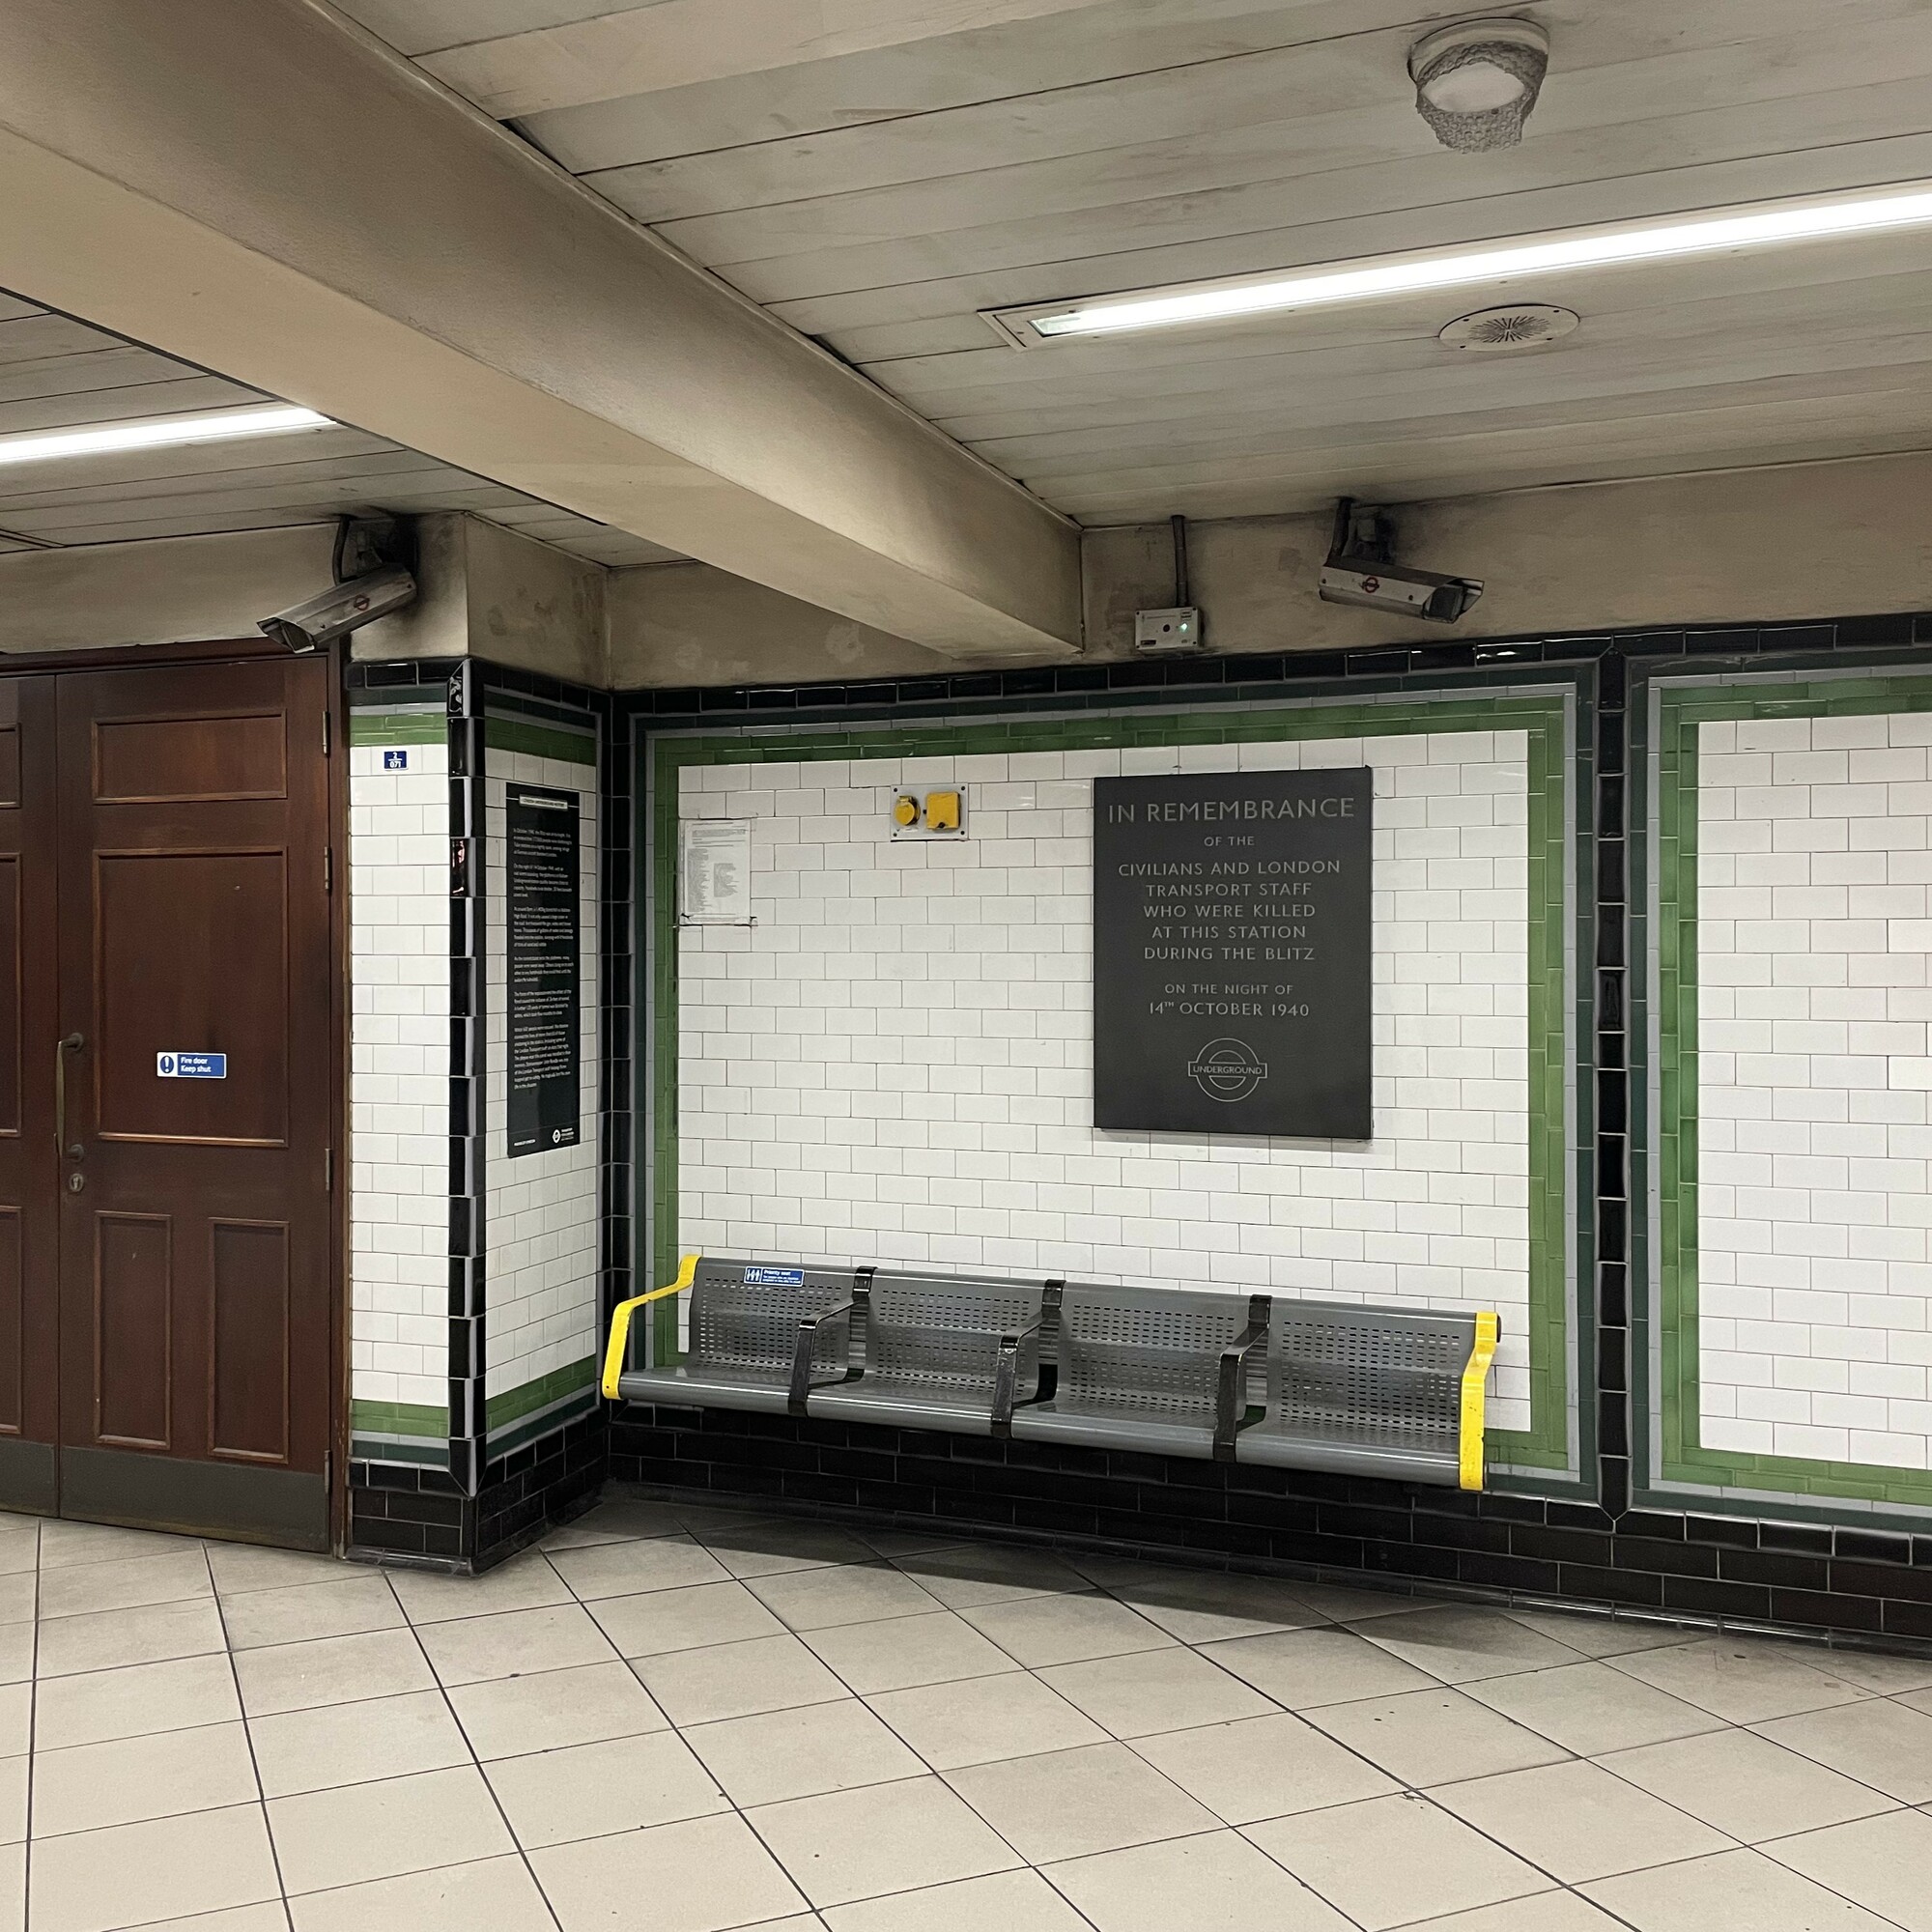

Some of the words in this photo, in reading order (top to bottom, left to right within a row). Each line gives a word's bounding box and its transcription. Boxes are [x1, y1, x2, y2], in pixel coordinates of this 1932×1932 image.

[1109, 804, 1134, 823] IN
[1147, 797, 1354, 822] REMEMBRANCE
[1204, 836, 1222, 847] OF
[1227, 836, 1255, 846] THE
[1118, 862, 1203, 877] CIVILIANS
[1209, 862, 1250, 875] AND
[1258, 859, 1340, 874] LONDON
[1145, 883, 1252, 897] TRANSPORT
[1259, 882, 1312, 896] STAFF
[1143, 904, 1187, 918] WHO
[1194, 904, 1244, 918] WERE
[1253, 903, 1316, 918] KILLED
[1151, 925, 1173, 939] AT
[1179, 925, 1219, 939] THIS
[1228, 925, 1306, 939] STATION
[1144, 947, 1213, 960] DURING
[1220, 947, 1256, 960] THE
[1264, 947, 1316, 961] BLITZ
[1164, 983, 1186, 994] ON
[1191, 983, 1218, 995] THE
[1224, 983, 1269, 995] NIGHT
[1274, 984, 1293, 996] OF
[1179, 1002, 1264, 1017] OCTOBER
[1271, 1003, 1310, 1017] 1940
[1193, 1065, 1263, 1074] UNDERGROUND
